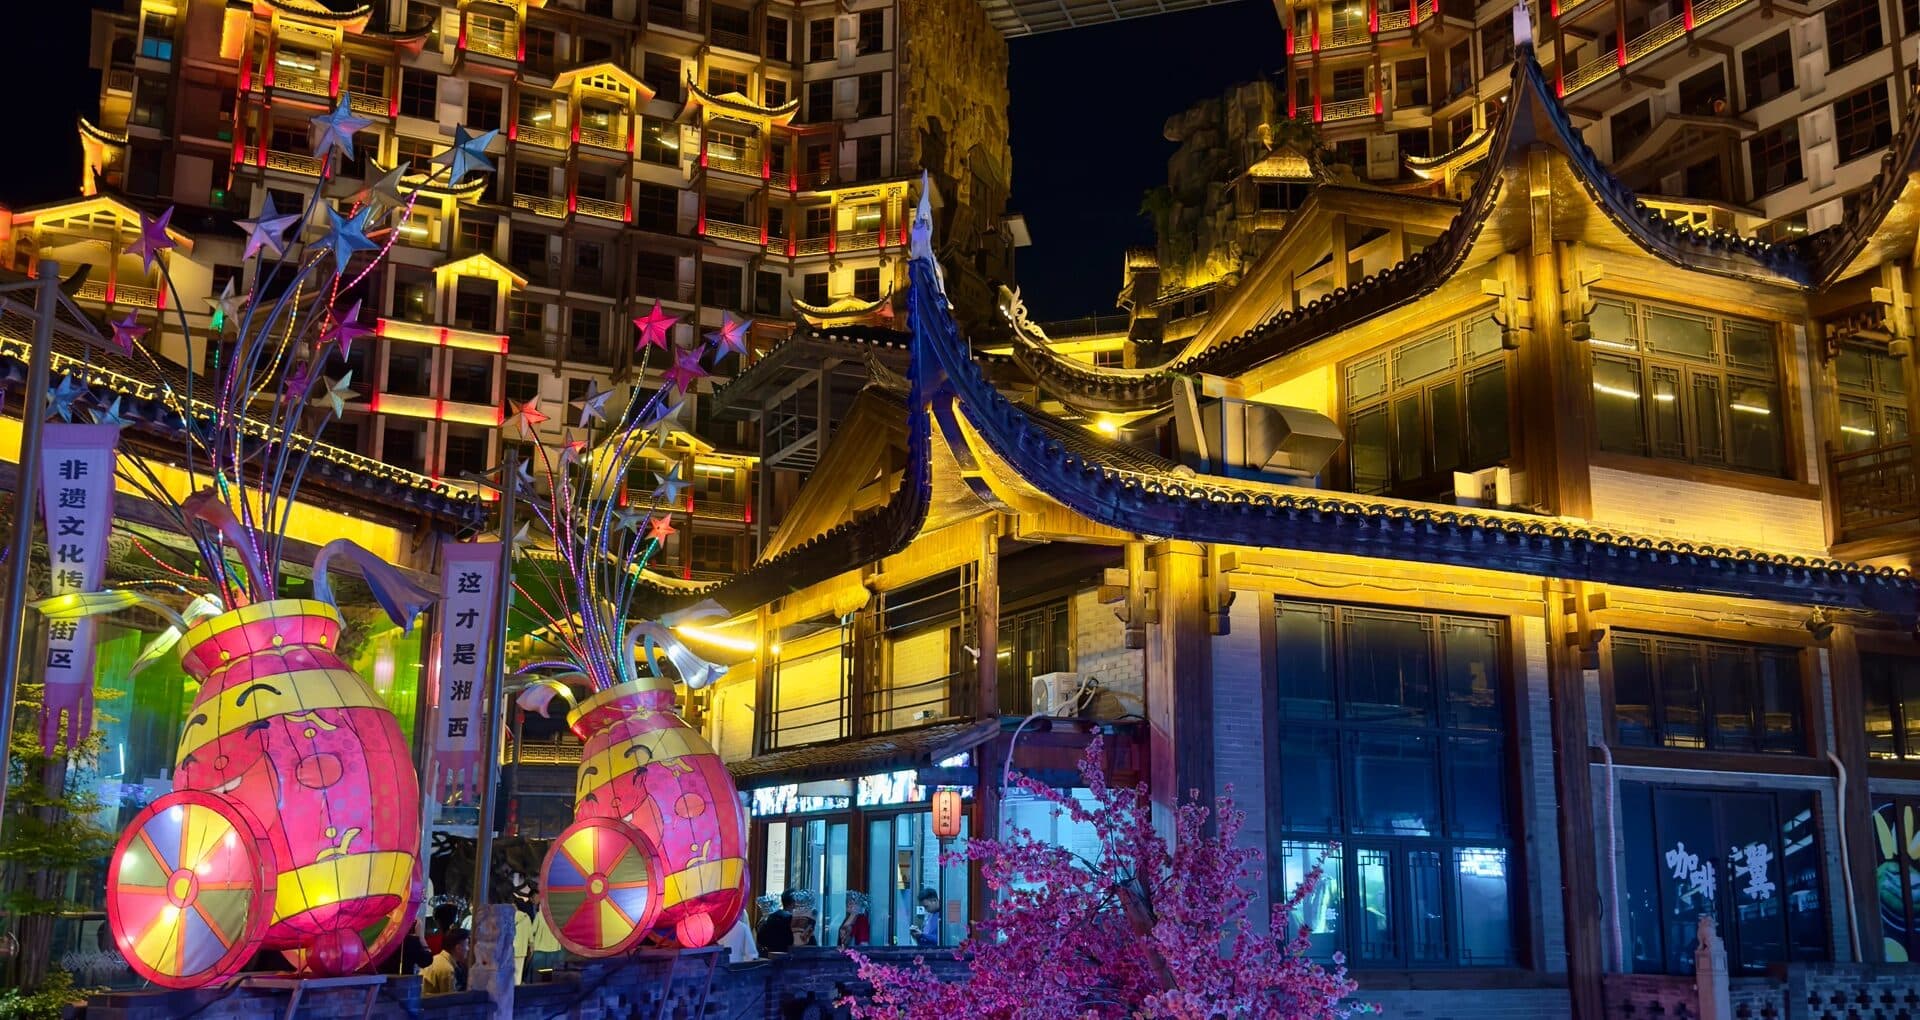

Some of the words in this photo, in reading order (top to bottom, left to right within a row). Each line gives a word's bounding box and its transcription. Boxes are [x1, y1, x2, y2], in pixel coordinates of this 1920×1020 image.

[46, 459, 88, 669] 非遗文化传街区
[447, 572, 482, 738] 这才是湘西
